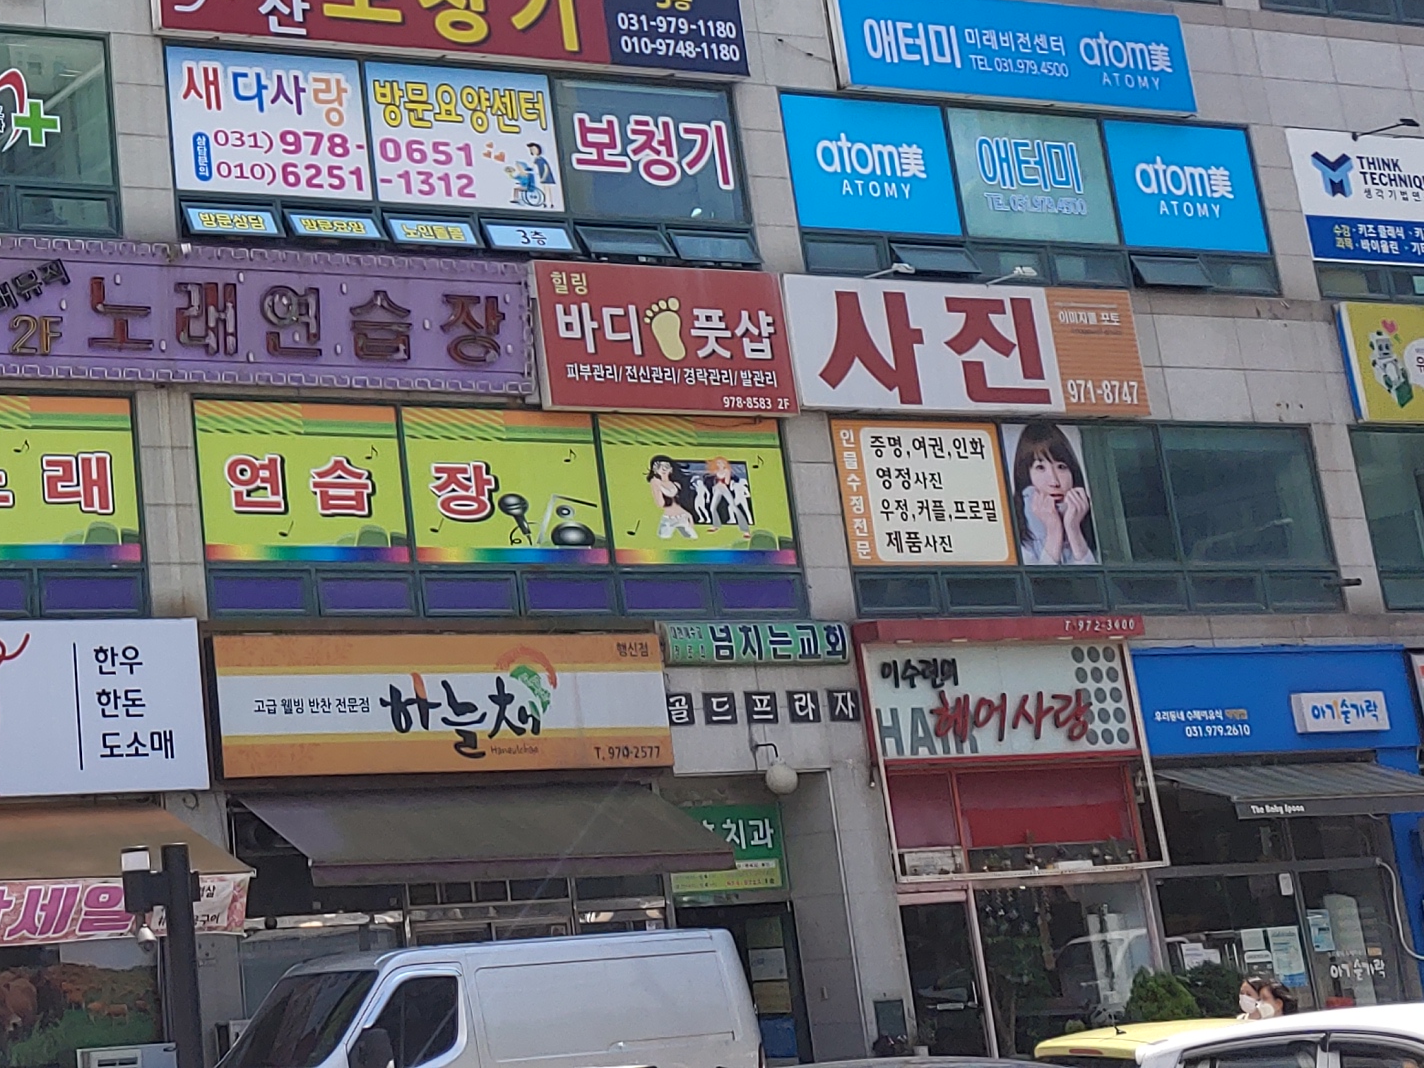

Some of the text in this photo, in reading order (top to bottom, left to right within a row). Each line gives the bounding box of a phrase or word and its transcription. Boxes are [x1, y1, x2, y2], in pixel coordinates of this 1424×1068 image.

[616, 11, 738, 40] 031-979-1180
[619, 35, 741, 63] 010-9748-1180
[863, 18, 961, 69] 애터미
[965, 28, 1066, 57] 미래비전센터
[968, 54, 1069, 78] TEL 031.979.4500
[1102, 72, 1160, 91] ATOMY
[373, 79, 547, 135] 방문요양센터
[570, 112, 735, 190] 보청기
[1356, 155, 1402, 173] THINK
[976, 136, 1084, 194] 애터미
[842, 179, 913, 201] ATOMY
[1359, 171, 1424, 191] TECHNIQ
[198, 211, 266, 231] 방문상담
[1158, 199, 1223, 220] ATOMY
[301, 217, 366, 235] 방문요양
[550, 271, 588, 295] 힐링
[8, 314, 63, 356] 2F
[555, 302, 776, 360] 바디 풋샵
[818, 290, 1052, 405] 사진
[740, 371, 778, 388] 발관리
[1066, 380, 1139, 406] 971-8747
[723, 397, 789, 410] 978-8583 2F
[886, 531, 953, 554] 제품사진
[616, 642, 649, 657] 행신점
[708, 624, 847, 661] 넘치는교회
[93, 646, 143, 676] 한우
[96, 688, 146, 719] 한돈
[253, 699, 278, 715] 고급
[308, 698, 331, 714] 반찬
[335, 697, 371, 714] 전문점
[668, 692, 855, 723] 골드프라자
[930, 688, 1093, 743] 헤어사랑
[1185, 724, 1251, 738] 031.979.2610
[100, 729, 175, 761] 도소매
[722, 818, 774, 850] 치과
